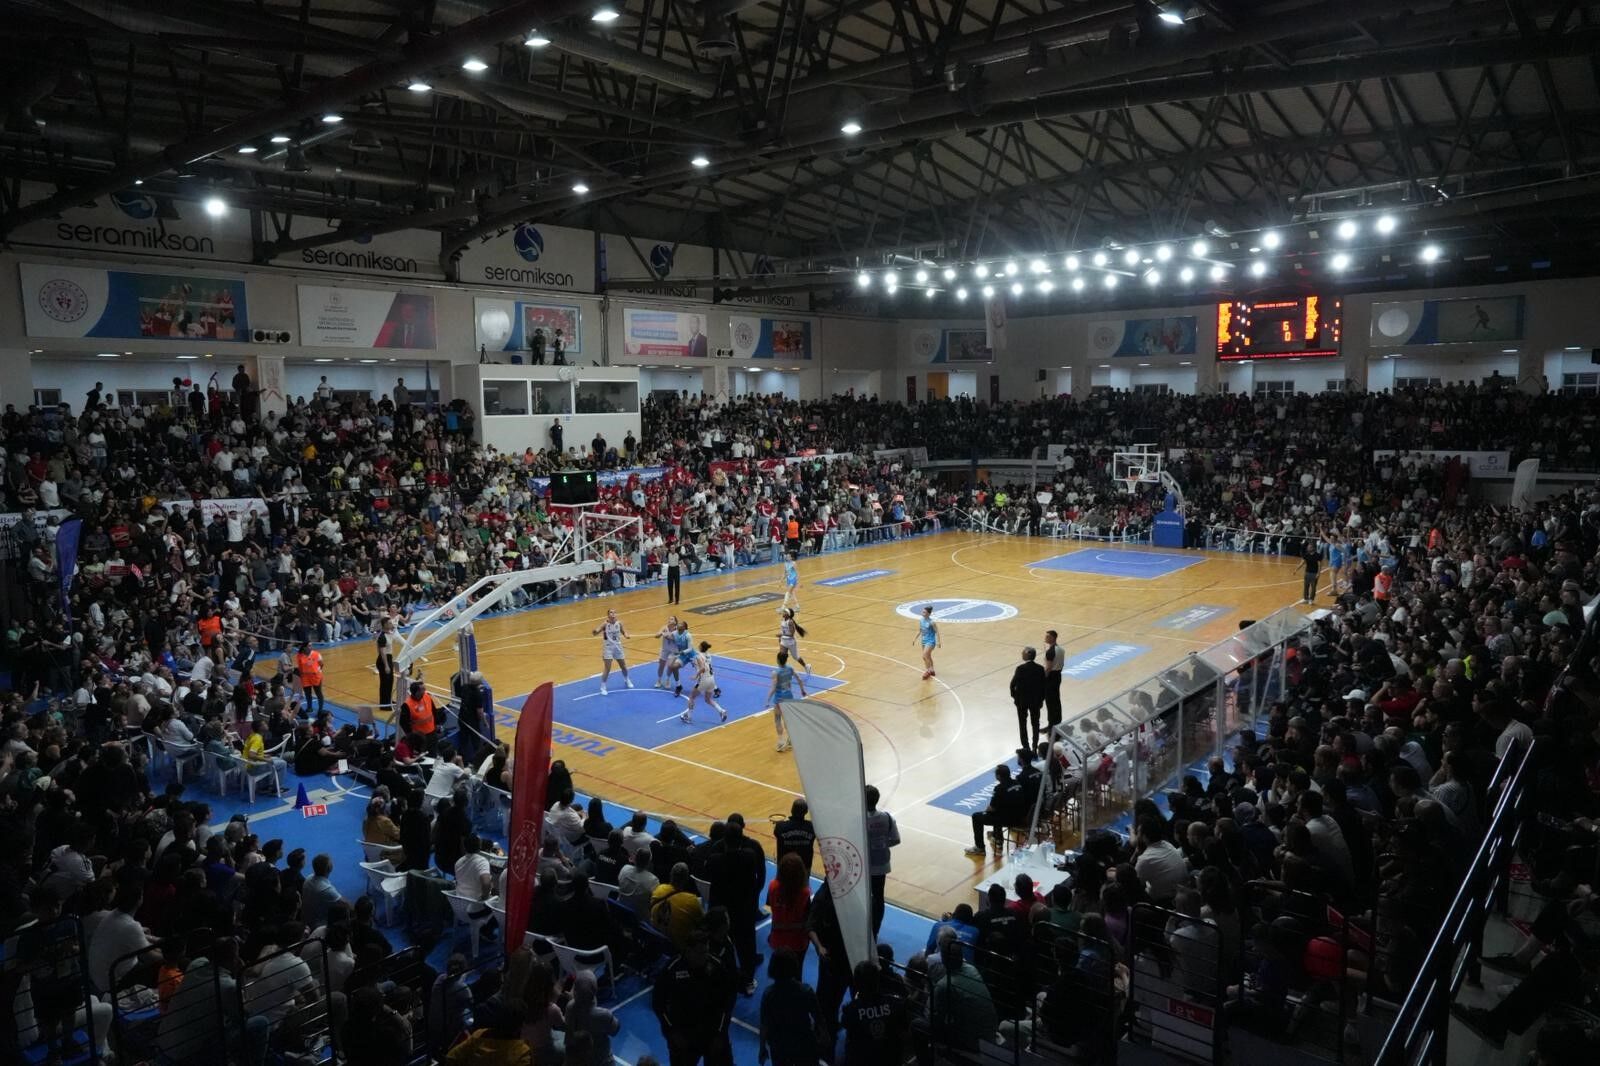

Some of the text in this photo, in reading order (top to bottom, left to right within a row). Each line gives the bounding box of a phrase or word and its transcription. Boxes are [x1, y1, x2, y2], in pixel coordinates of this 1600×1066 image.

[57, 222, 213, 254] seramiksan
[302, 248, 417, 272] seramiksan
[485, 266, 574, 287] seramiksan
